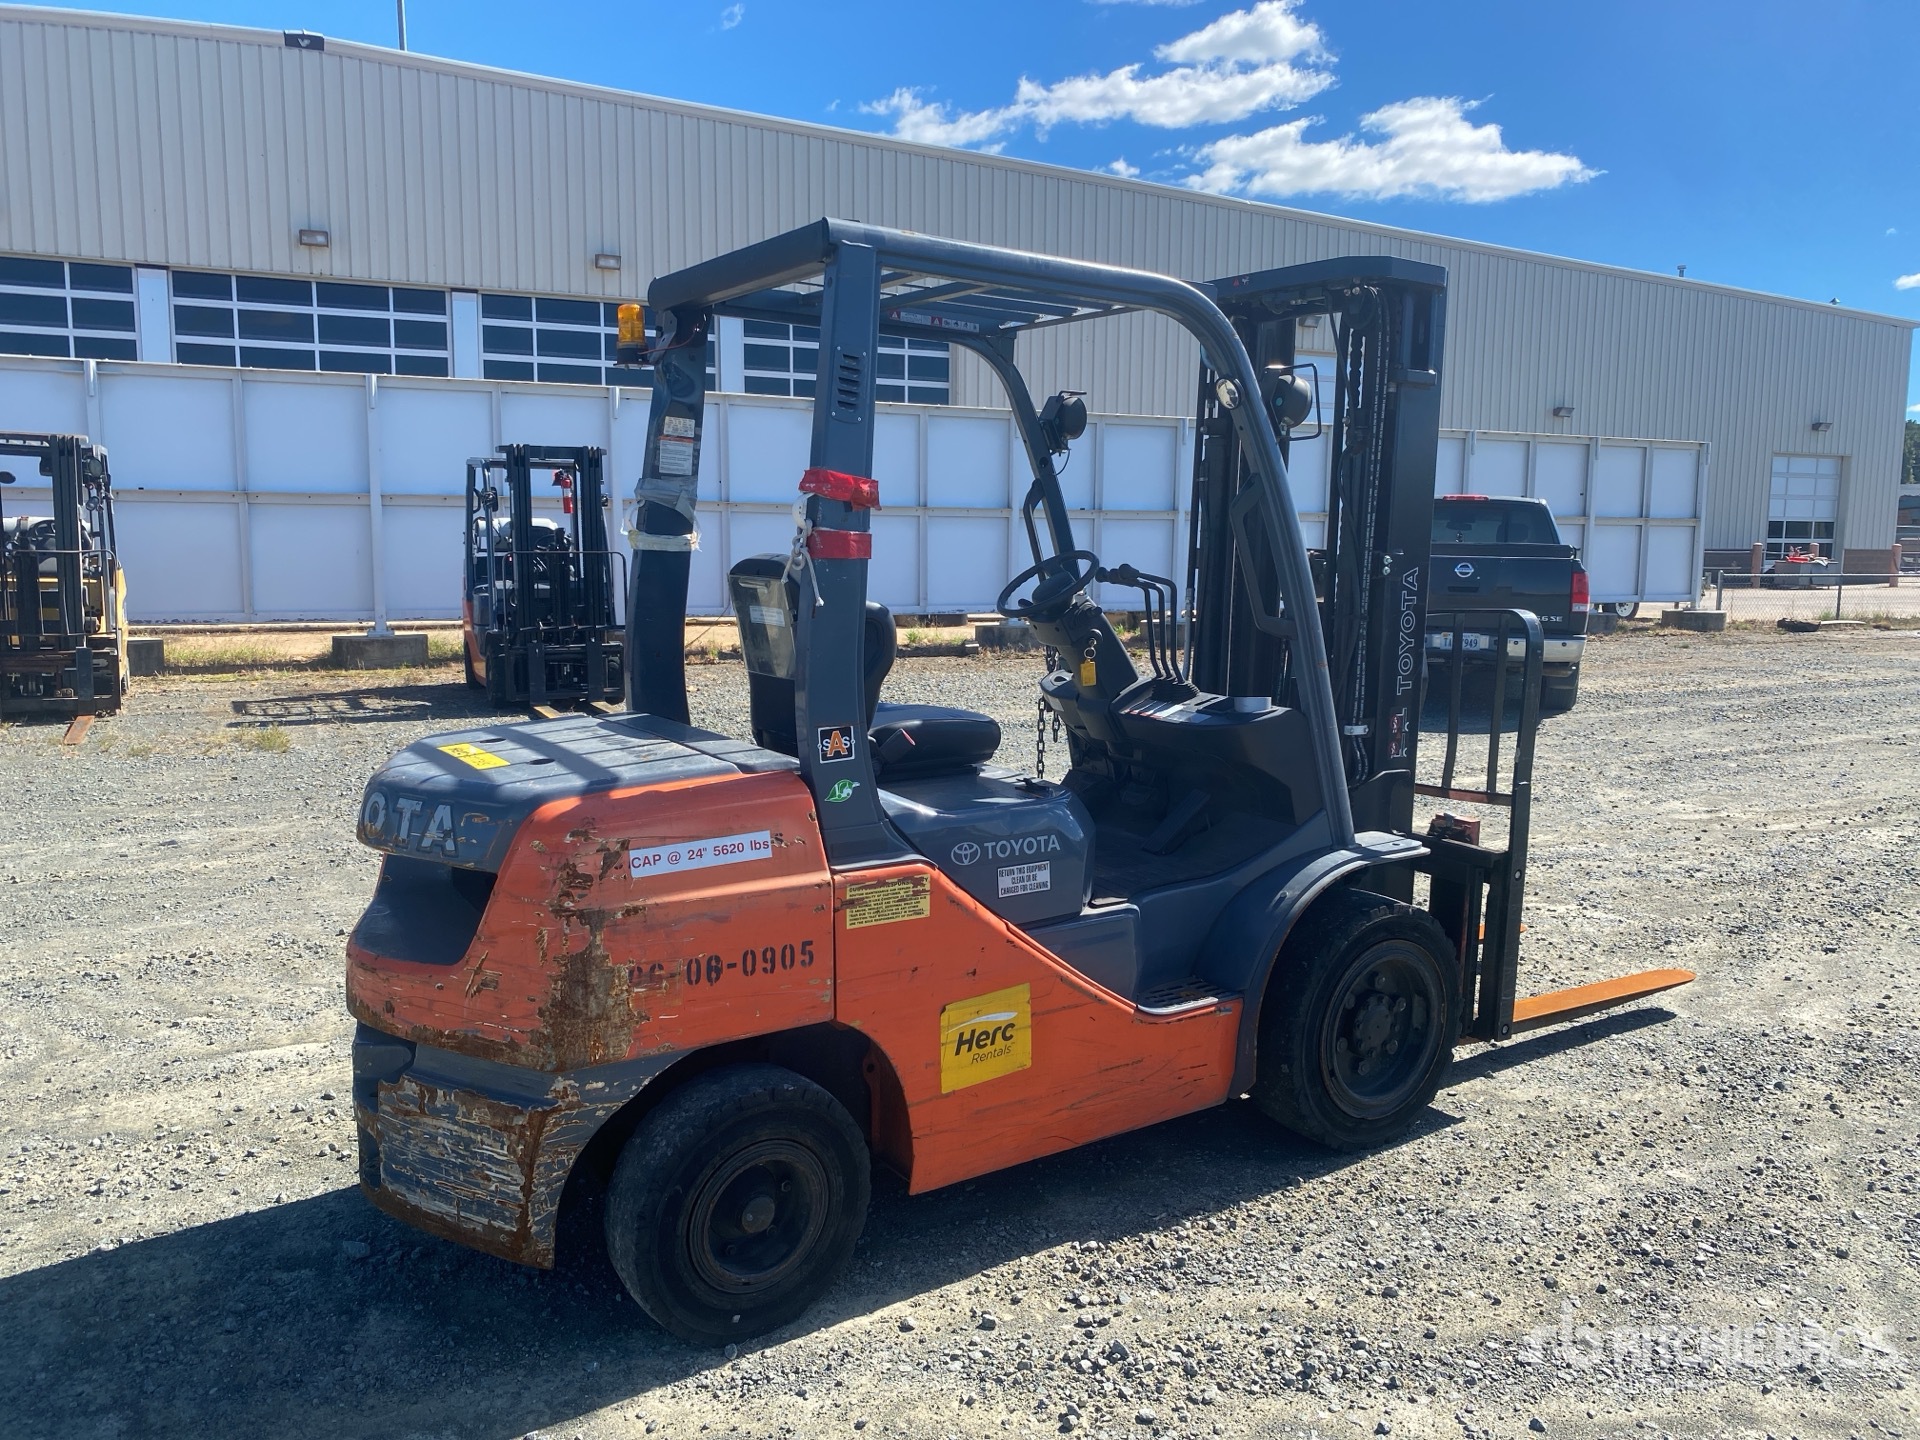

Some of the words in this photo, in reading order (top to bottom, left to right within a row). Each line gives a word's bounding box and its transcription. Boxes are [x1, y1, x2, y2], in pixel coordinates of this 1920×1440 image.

[1397, 567, 1418, 695] TOYOTA
[631, 853, 662, 869] CAP
[667, 851, 681, 865] @
[687, 847, 707, 861] 24"
[713, 842, 745, 857] 5620
[750, 839, 770, 851] lbs
[983, 834, 1061, 860] TOYOTA
[954, 1022, 1016, 1057] Herc
[970, 1043, 1012, 1065] Rentals
